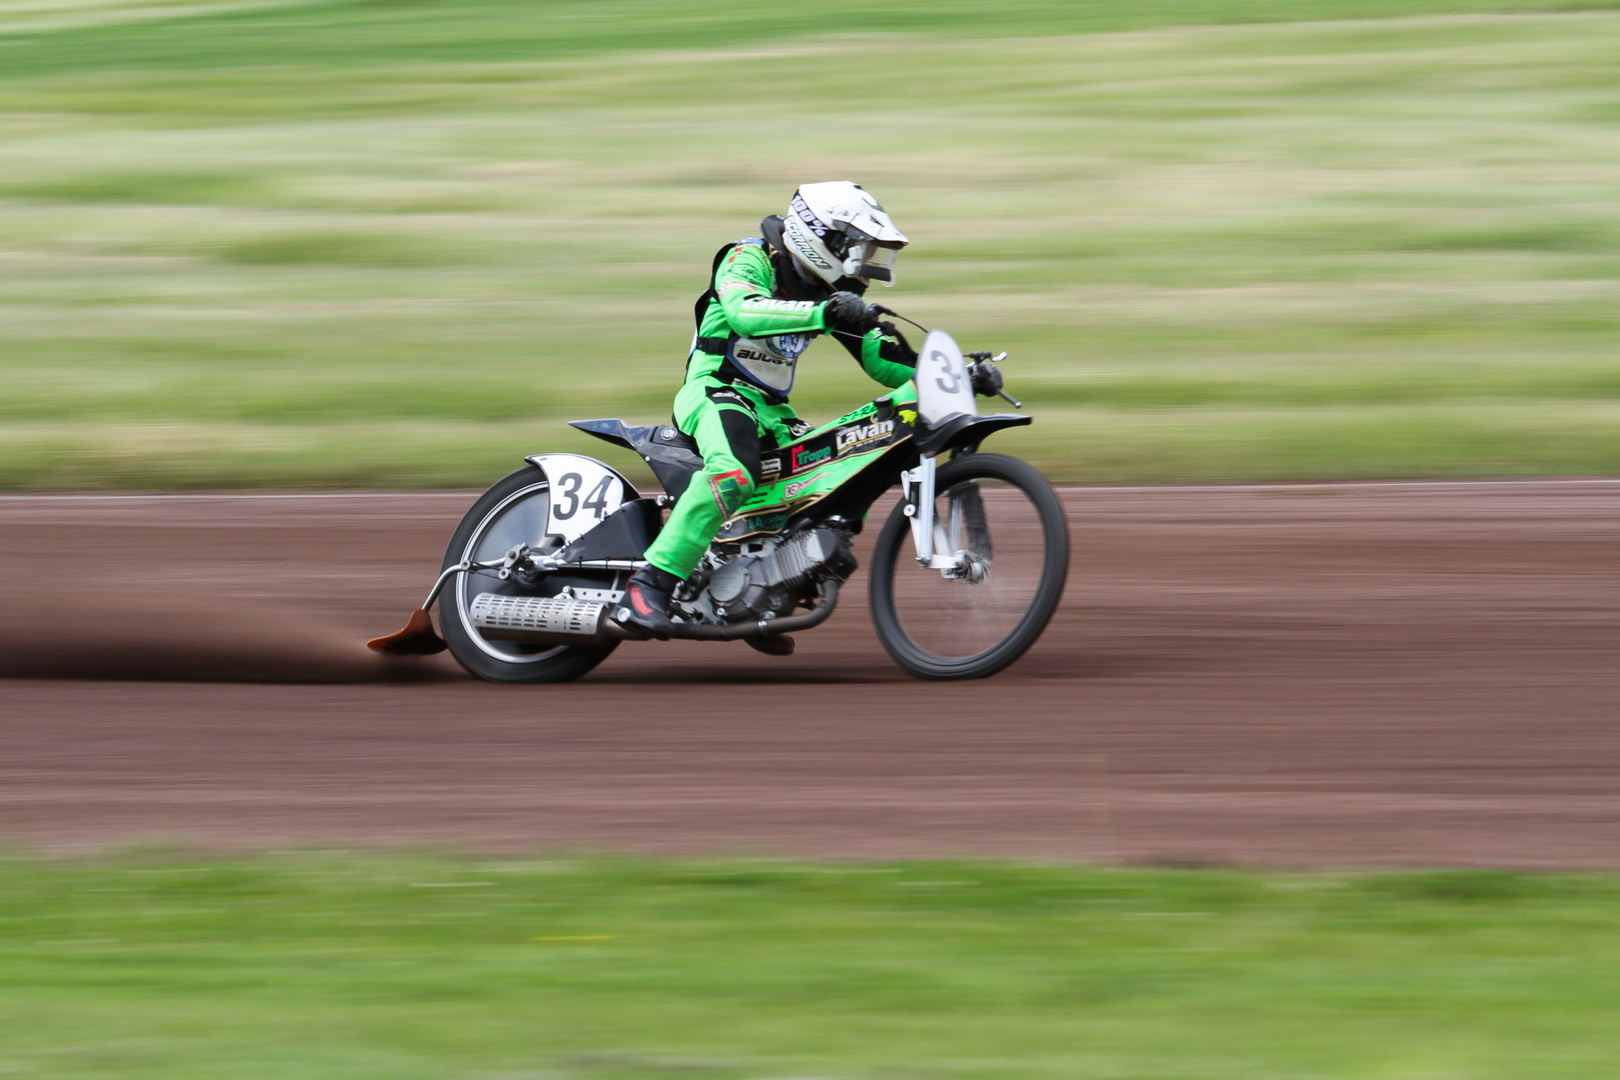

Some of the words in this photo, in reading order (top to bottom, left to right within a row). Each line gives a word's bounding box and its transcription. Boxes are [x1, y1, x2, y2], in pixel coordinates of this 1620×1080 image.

[791, 194, 829, 237] 100%
[836, 420, 895, 450] Lavan
[797, 446, 831, 465] Trapp
[553, 472, 614, 521] 34
